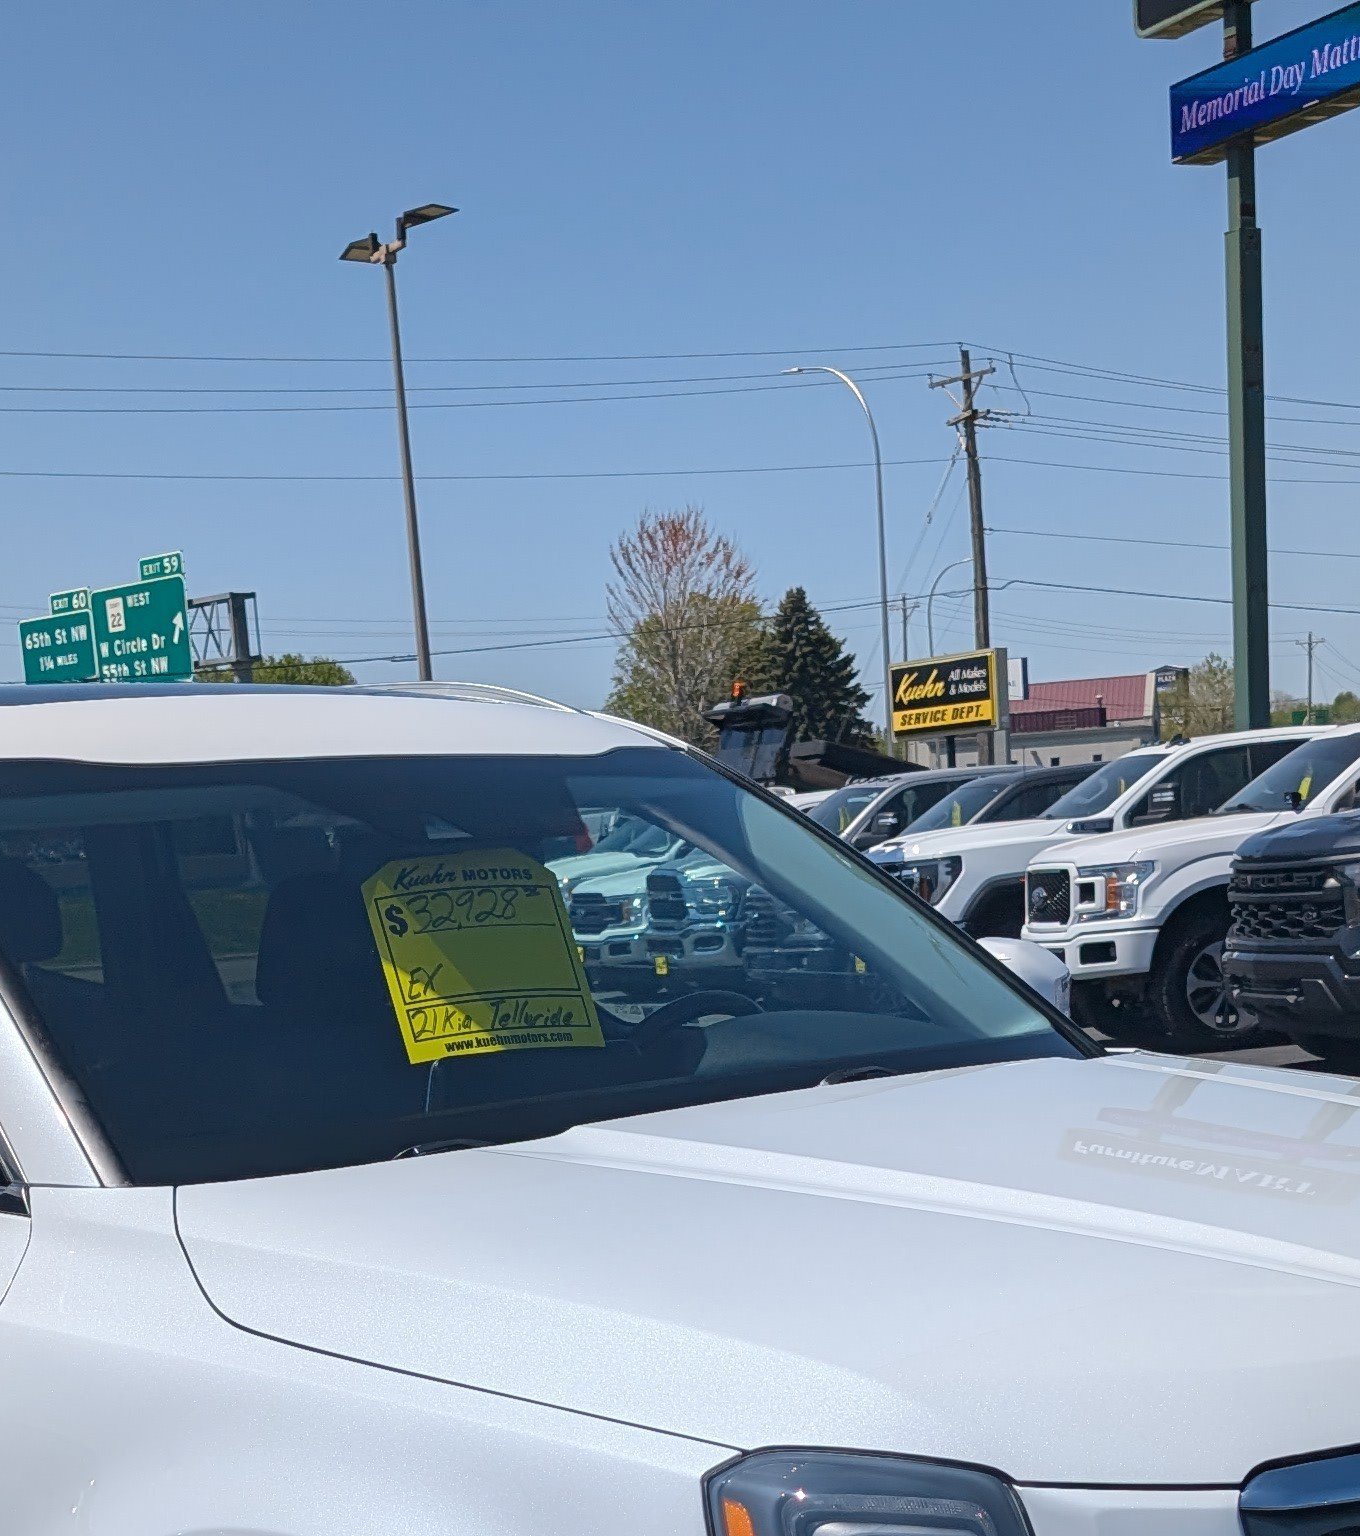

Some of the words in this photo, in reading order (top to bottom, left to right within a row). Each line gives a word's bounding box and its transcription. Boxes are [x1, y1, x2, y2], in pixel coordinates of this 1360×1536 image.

[1179, 70, 1266, 133] Memorial
[1269, 61, 1306, 95] Day
[162, 556, 179, 574] 59
[72, 592, 87, 608] 60
[126, 591, 151, 608] WEST
[111, 612, 123, 628] 22
[25, 631, 51, 650] 65th
[54, 628, 68, 645] St
[70, 624, 87, 642] NW
[114, 636, 148, 656] Circle
[151, 633, 166, 650] Dr
[101, 662, 130, 678] 55th
[134, 660, 147, 676] St
[150, 656, 169, 674] NW
[947, 668, 961, 681] All
[961, 665, 987, 680] Makes
[894, 668, 946, 705] Kuehn
[949, 684, 956, 695] &
[957, 680, 987, 694] Models
[900, 708, 948, 727] SERVICE
[951, 704, 984, 721] DEPT.
[393, 863, 457, 891] Kuehn
[461, 867, 534, 881] MOTORS
[384, 903, 409, 938] $
[408, 963, 444, 1001] EX
[442, 1006, 473, 1032] Kia
[490, 999, 574, 1030] Telluride
[444, 1031, 574, 1052] www.kuehnmotors.com
